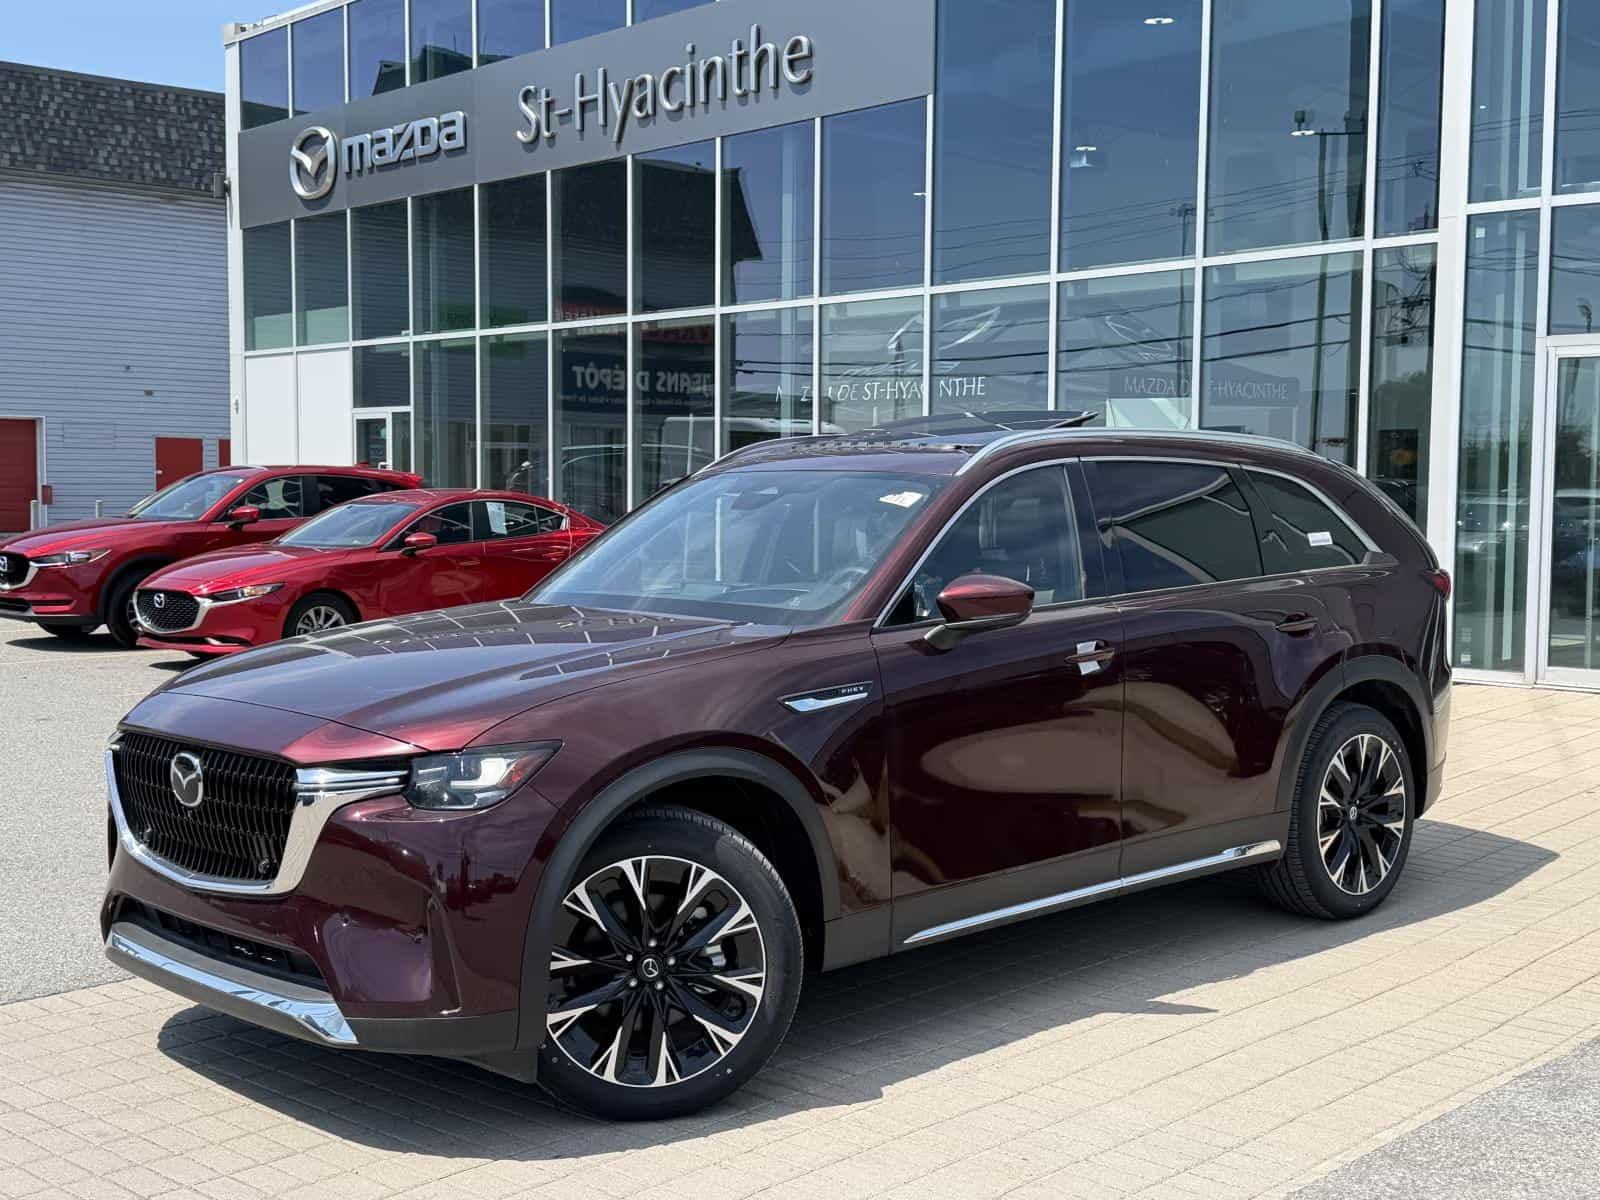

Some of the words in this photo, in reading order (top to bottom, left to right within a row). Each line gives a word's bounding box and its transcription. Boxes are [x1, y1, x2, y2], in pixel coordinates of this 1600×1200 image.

[341, 111, 466, 173] mazda
[516, 23, 813, 144] St-Hyacinthe
[837, 383, 859, 401] DE
